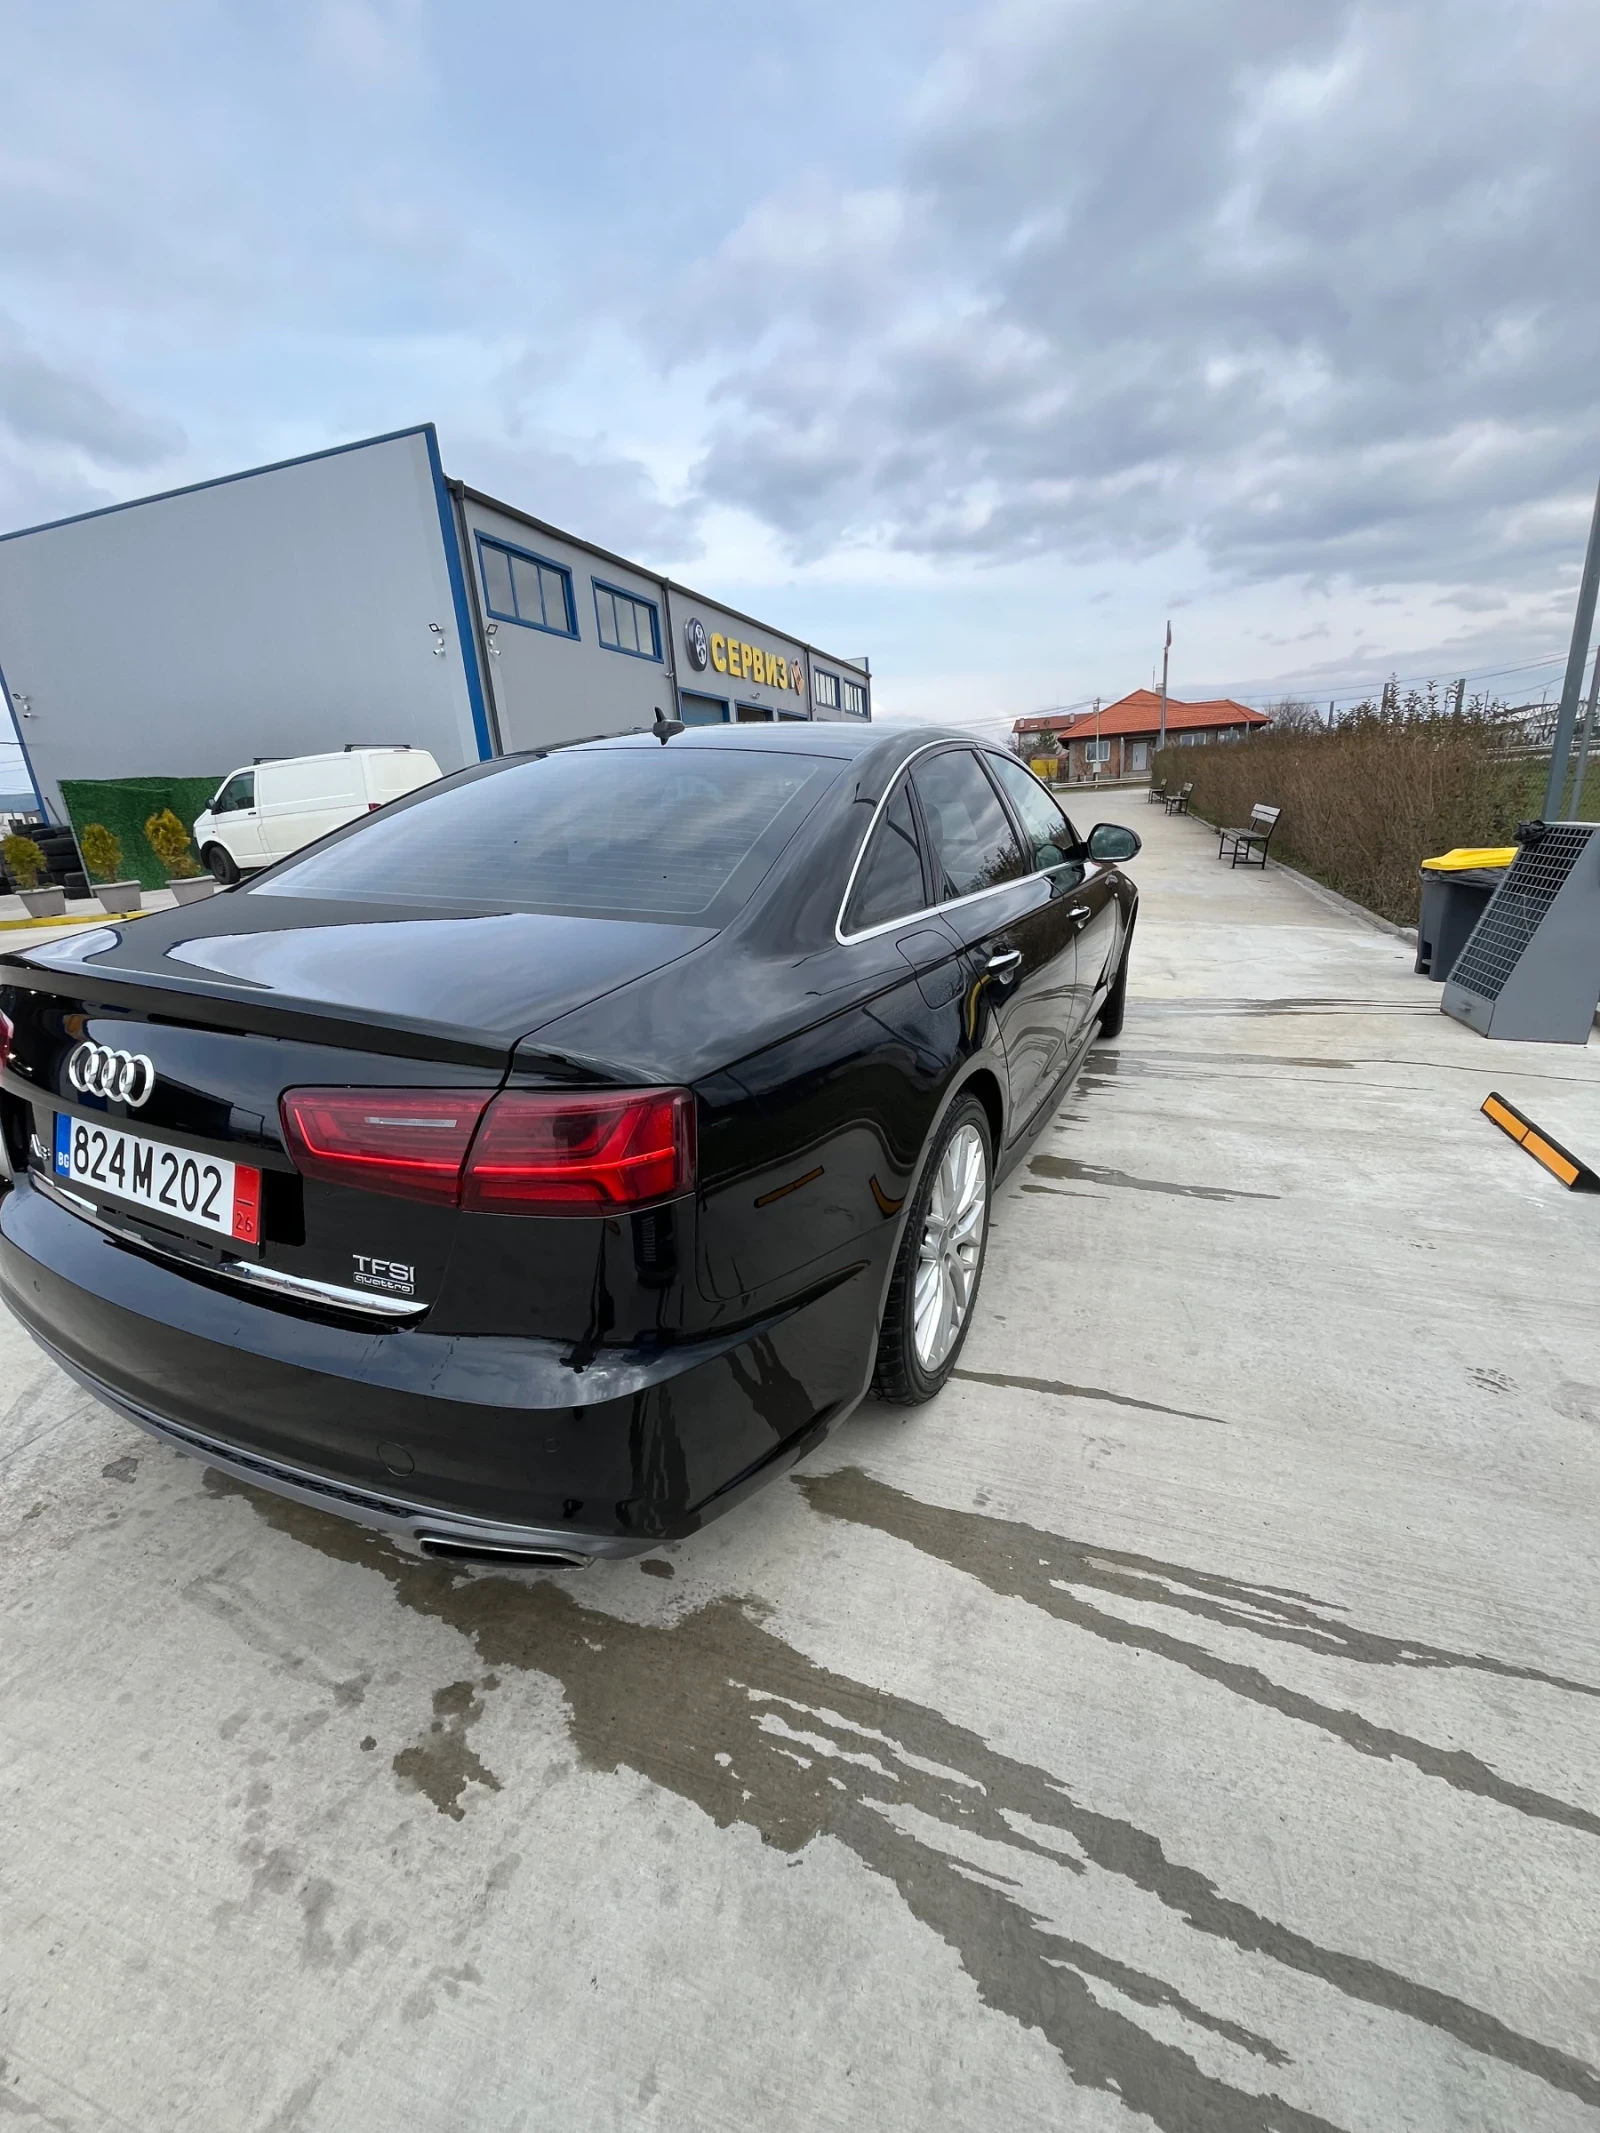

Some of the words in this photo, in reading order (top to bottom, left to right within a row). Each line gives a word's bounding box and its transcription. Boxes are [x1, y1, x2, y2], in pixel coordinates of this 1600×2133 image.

[711, 632, 788, 690] СЕРВИЗ
[58, 1151, 70, 1169] BG
[235, 1211, 254, 1233] 26
[352, 1254, 415, 1283] TFSI
[355, 1275, 411, 1292] quattro
